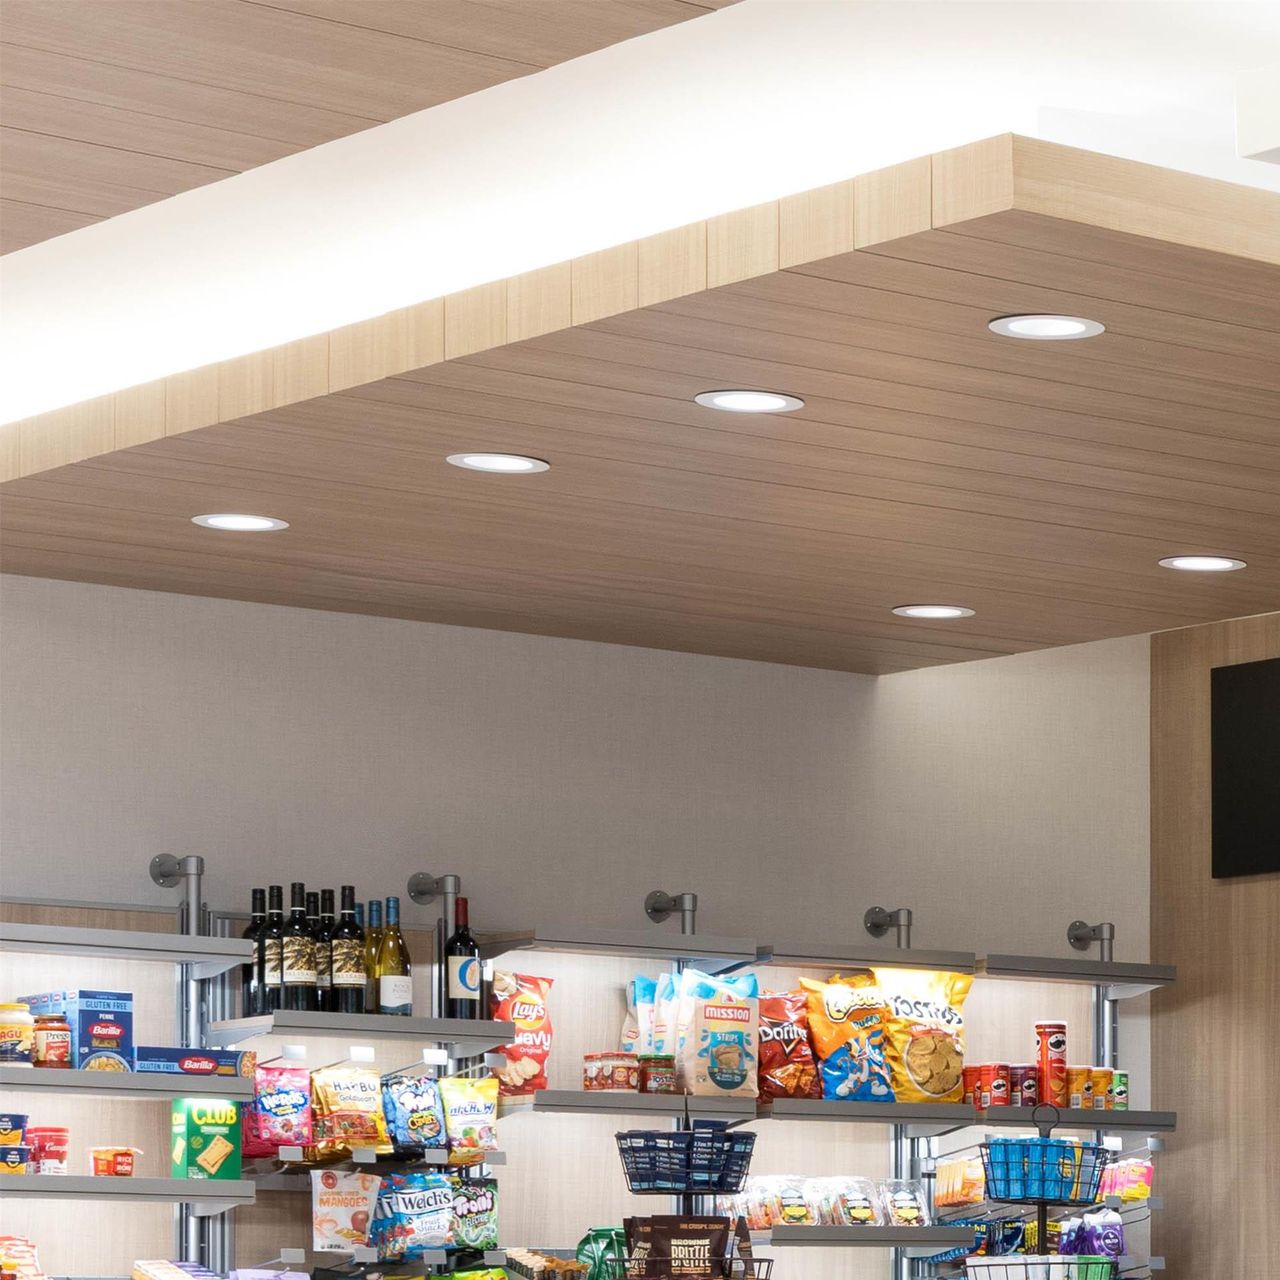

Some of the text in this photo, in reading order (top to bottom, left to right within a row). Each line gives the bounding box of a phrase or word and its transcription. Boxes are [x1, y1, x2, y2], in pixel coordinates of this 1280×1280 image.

[85, 1000, 127, 1010] GLUTEN FREE
[92, 1025, 122, 1036] Barilla
[46, 1032, 70, 1042] Prego
[717, 1033, 739, 1042] STRIPS
[139, 1062, 176, 1071] GLUTEN FREE
[183, 1060, 214, 1070] Barilla
[332, 1080, 378, 1092] HABO
[191, 1102, 238, 1125] CLUB
[320, 1197, 369, 1208] MANGOES
[401, 1190, 451, 1211] Welch's
[453, 1190, 493, 1218] Trolli
[671, 1246, 711, 1268] BRITTLE
